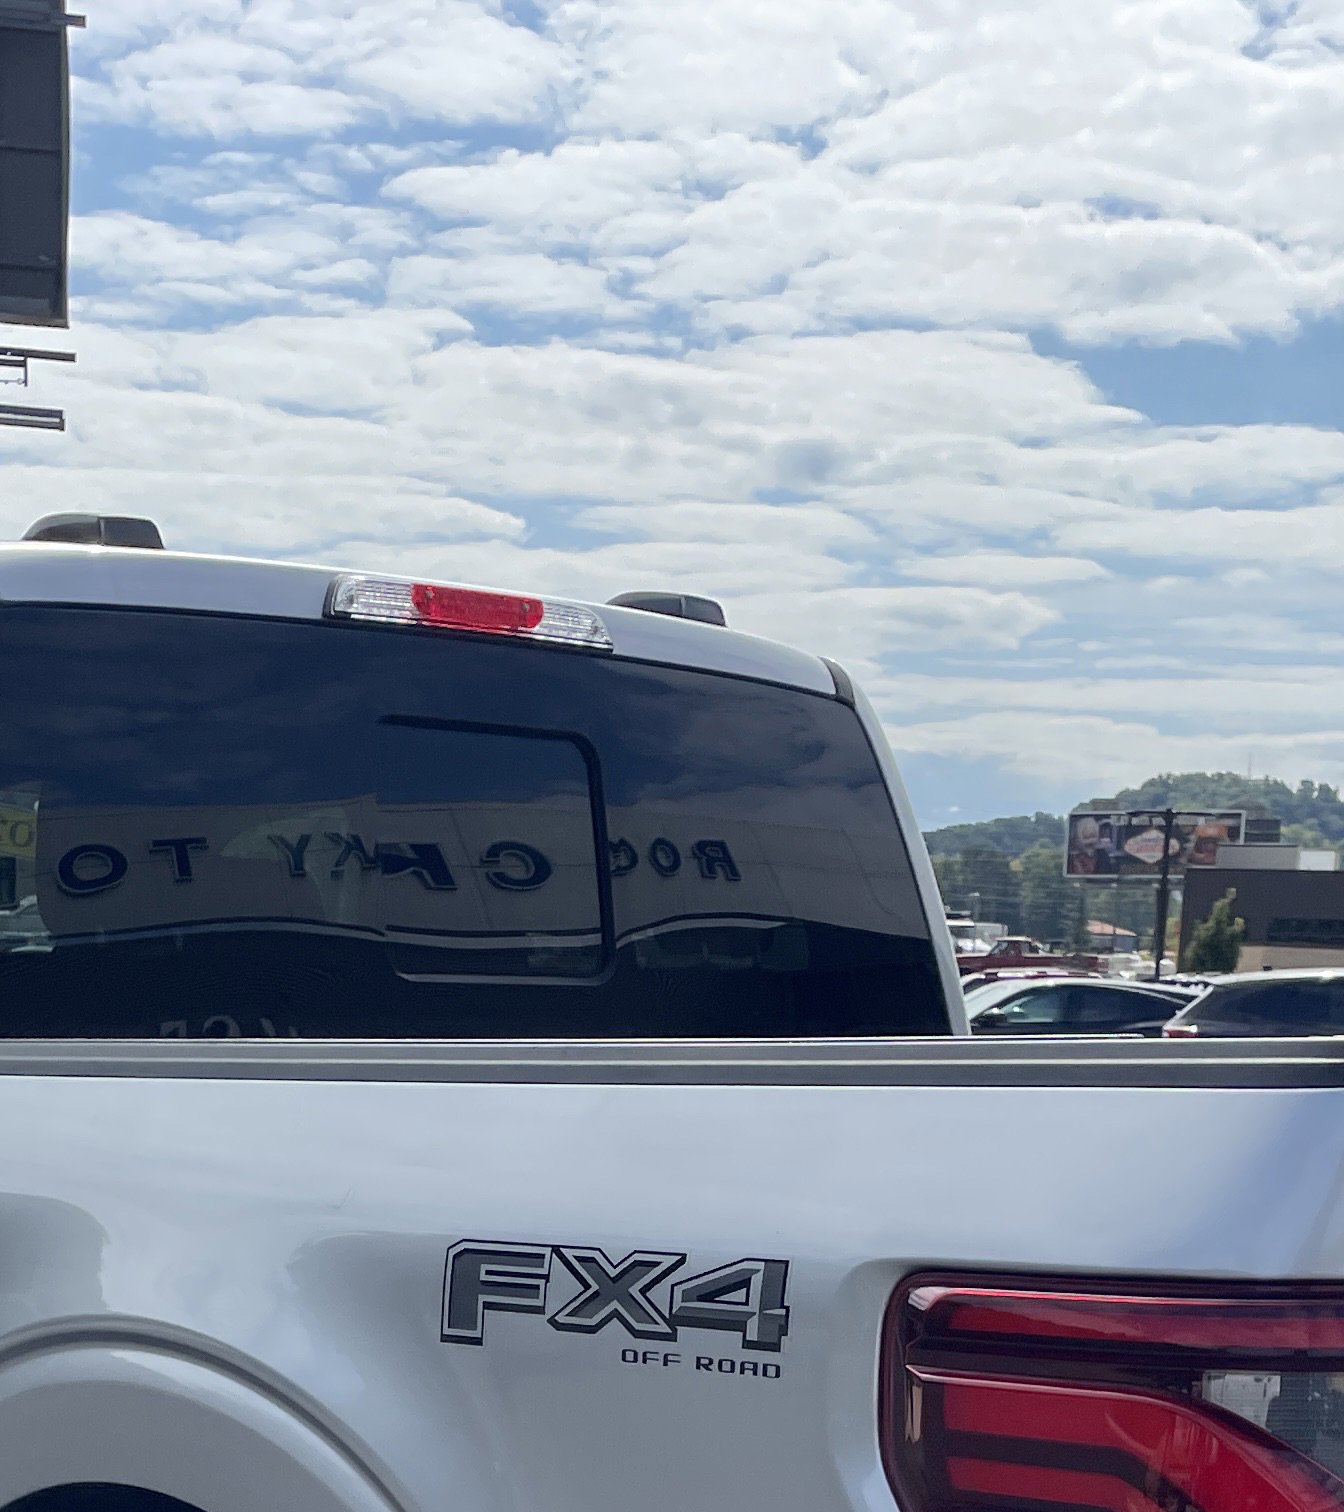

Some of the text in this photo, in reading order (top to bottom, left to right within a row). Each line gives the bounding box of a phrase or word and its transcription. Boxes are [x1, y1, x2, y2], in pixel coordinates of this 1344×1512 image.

[440, 1238, 790, 1352] FX4
[621, 1348, 781, 1380] OFF ROAD
